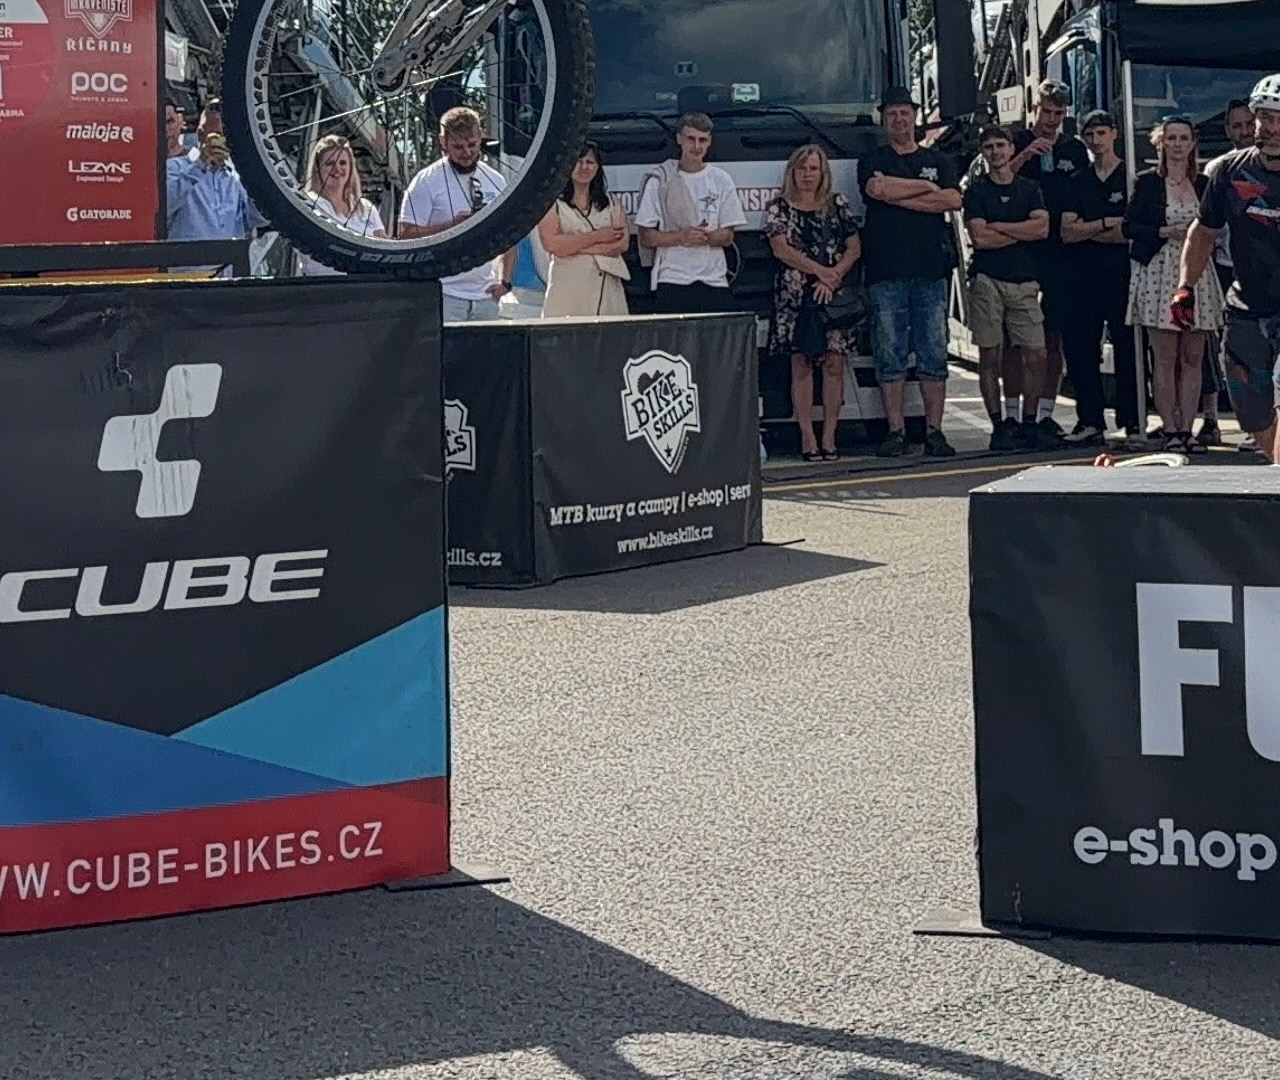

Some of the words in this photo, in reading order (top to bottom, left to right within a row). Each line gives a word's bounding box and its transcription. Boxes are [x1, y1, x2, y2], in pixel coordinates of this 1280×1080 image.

[66, 122, 119, 142] maloja
[68, 160, 131, 174] LEZYNE
[80, 209, 132, 220] GATORADE
[631, 370, 682, 429] BIKE
[653, 394, 694, 440] SKILLS
[550, 505, 584, 526] MTB
[586, 503, 624, 523] kurzy
[626, 503, 636, 516] a
[637, 495, 680, 516] campy
[687, 488, 723, 508] e-shop
[617, 525, 714, 553] www.bikeskills.cz
[1073, 817, 1278, 882] e-shop
